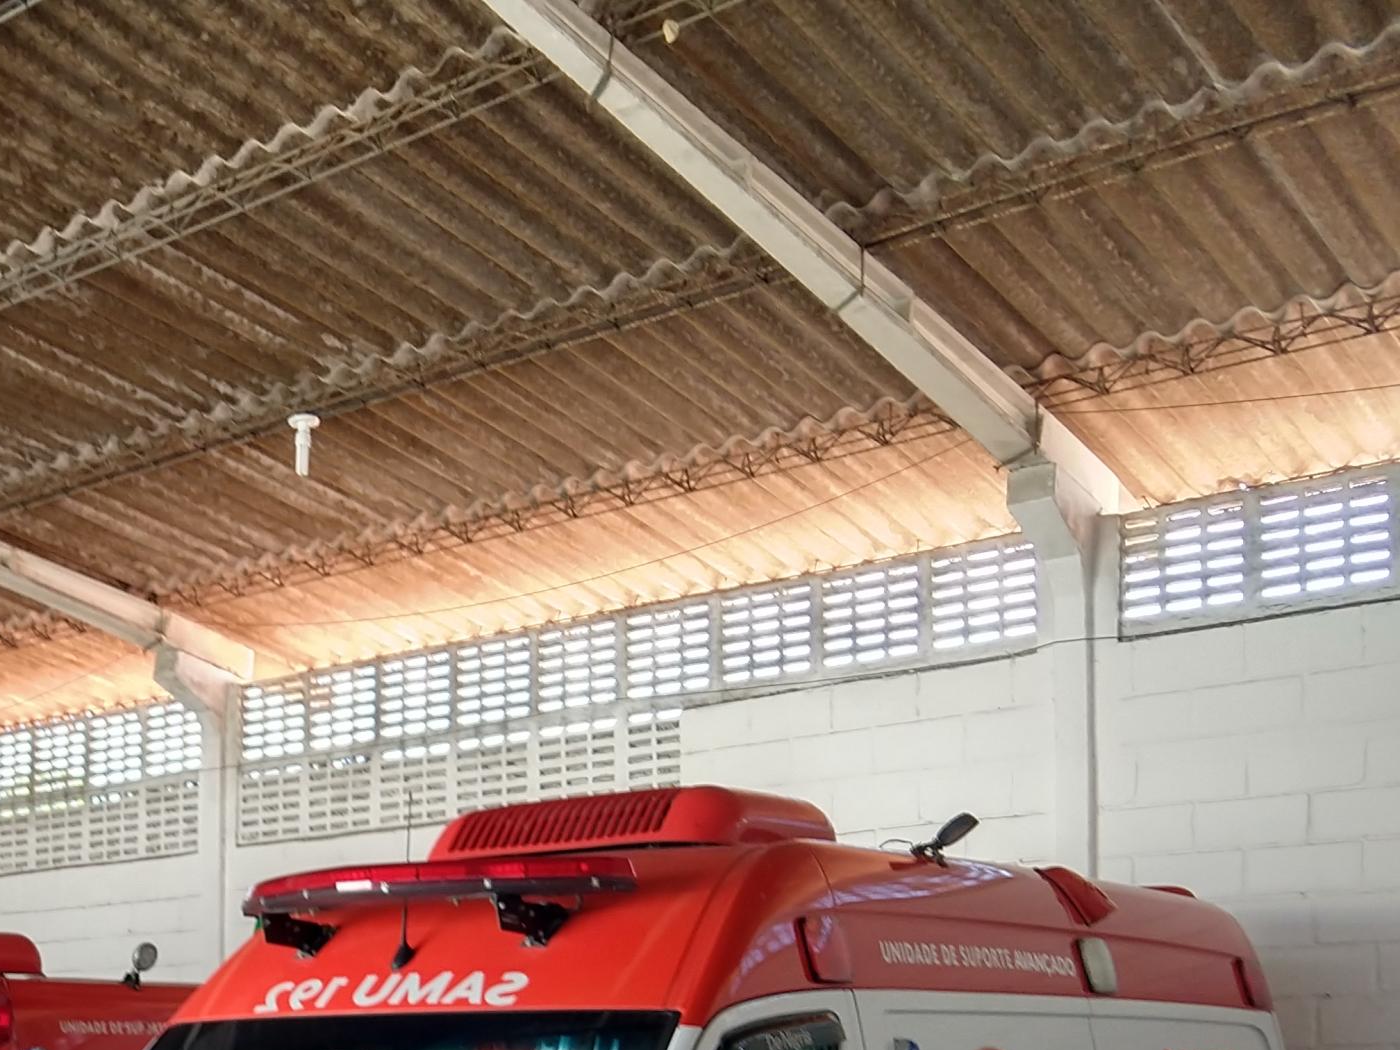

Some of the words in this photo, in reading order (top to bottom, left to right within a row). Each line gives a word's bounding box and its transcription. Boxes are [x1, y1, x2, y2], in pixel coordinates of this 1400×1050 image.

[878, 940, 940, 965] UNIDADE
[940, 944, 960, 966] DE
[960, 945, 1015, 969] SUPORTE
[1014, 950, 1076, 976] AVANÇADO
